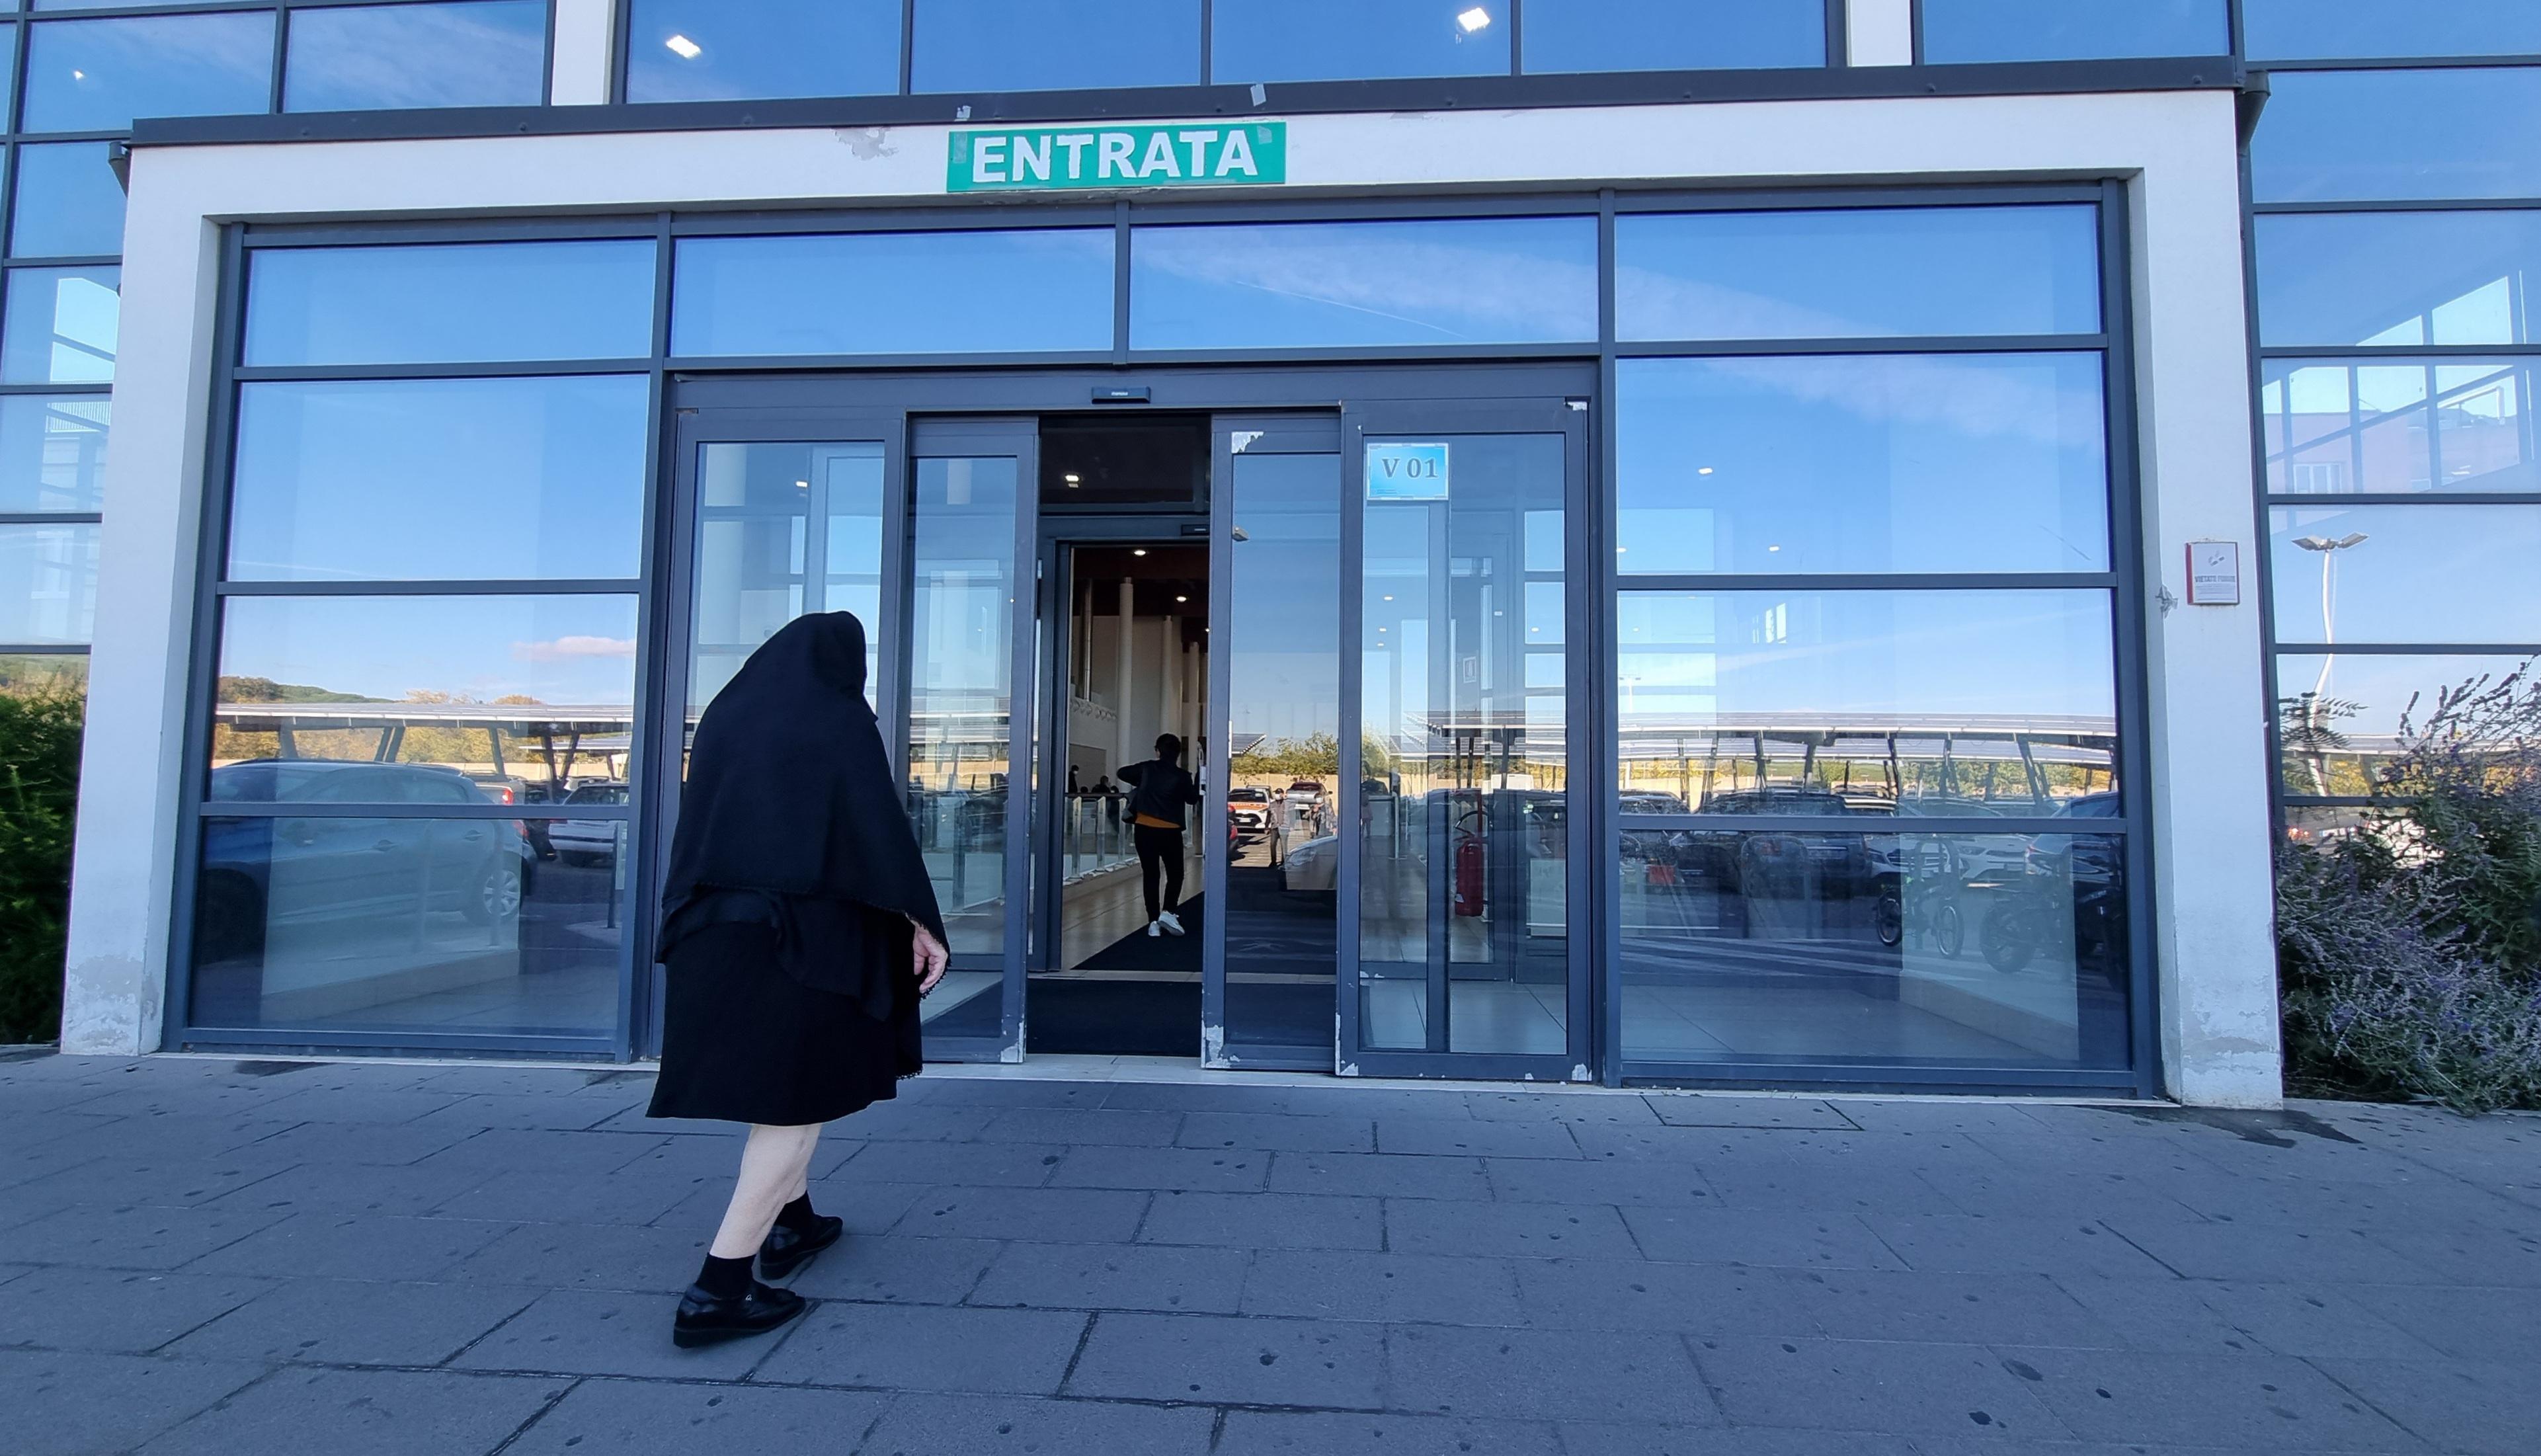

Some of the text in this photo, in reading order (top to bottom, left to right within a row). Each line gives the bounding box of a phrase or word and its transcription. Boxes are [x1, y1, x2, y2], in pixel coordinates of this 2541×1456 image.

[973, 130, 1258, 183] ENTRATA
[1382, 458, 1438, 478] V 01
